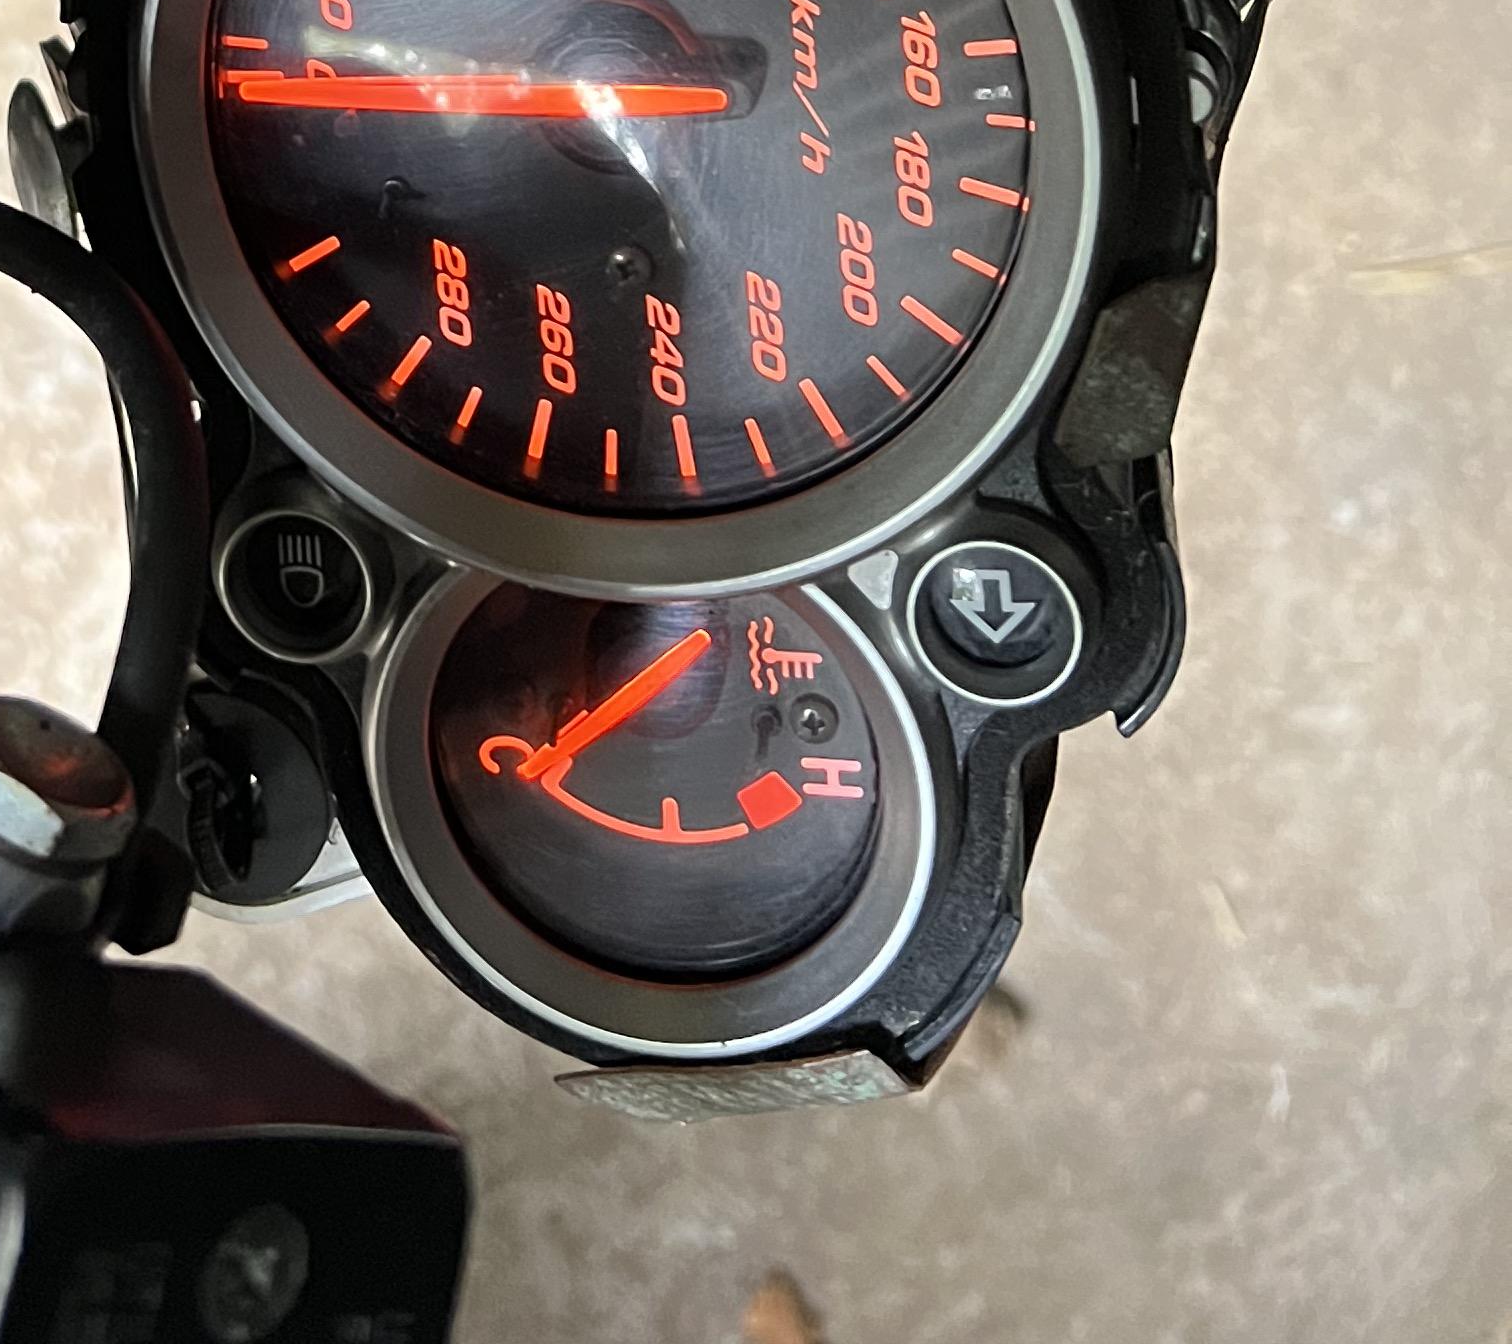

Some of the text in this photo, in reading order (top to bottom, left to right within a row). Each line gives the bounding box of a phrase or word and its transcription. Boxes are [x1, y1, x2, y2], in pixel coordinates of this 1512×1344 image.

[900, 11, 941, 107] 160
[893, 131, 934, 227] 180
[432, 238, 473, 347] 280
[837, 214, 878, 327] 200
[536, 283, 577, 395] 260
[645, 294, 687, 407] 240
[746, 271, 787, 382] 220
[801, 756, 864, 799] H
